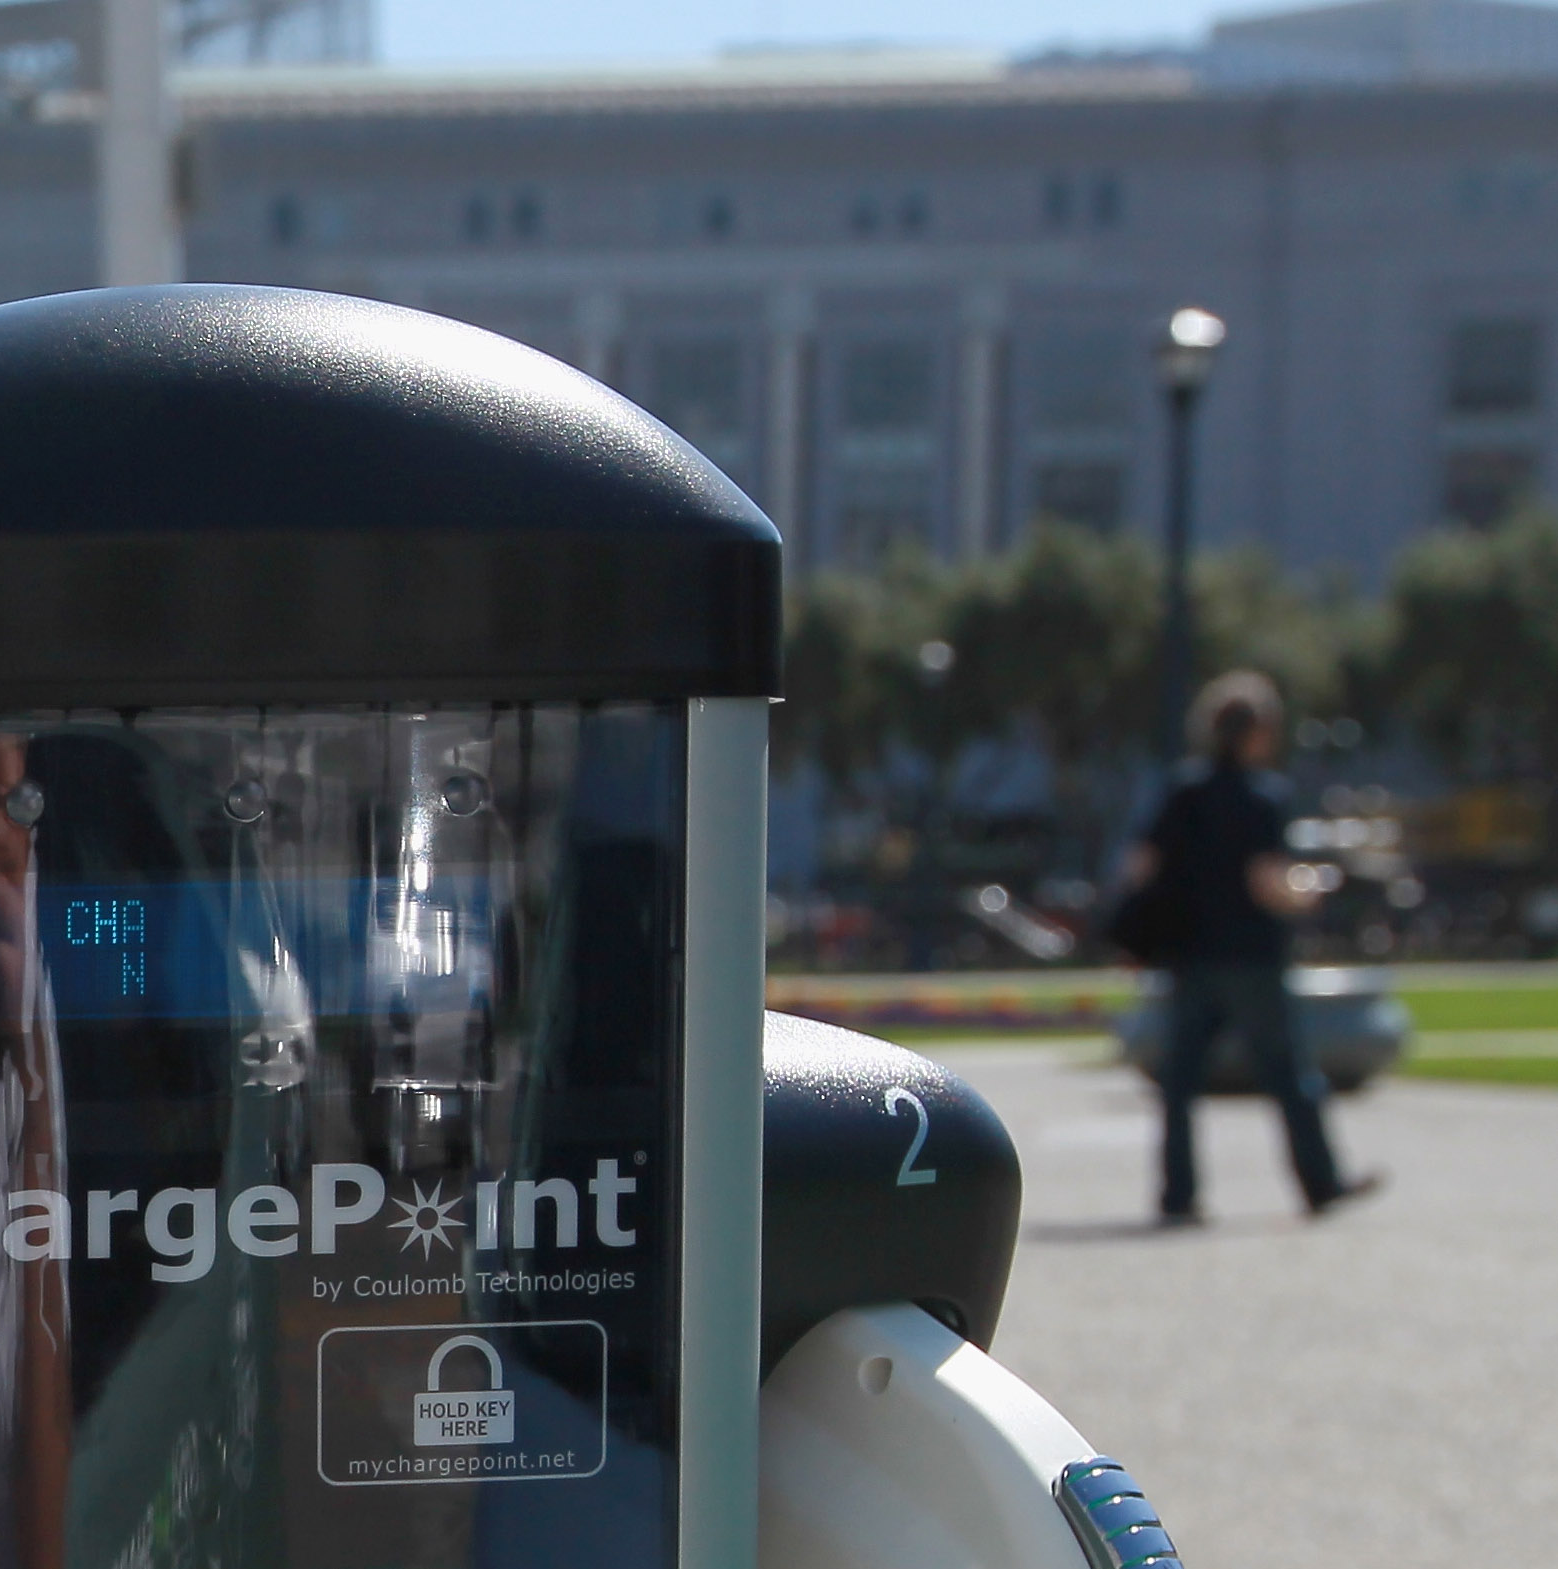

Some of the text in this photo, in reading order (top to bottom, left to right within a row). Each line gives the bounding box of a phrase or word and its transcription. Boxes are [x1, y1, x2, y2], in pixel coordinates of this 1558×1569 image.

[67, 900, 144, 944] CHA
[123, 952, 144, 995] N
[884, 1085, 937, 1186] 2
[313, 1268, 635, 1302] by Coulomb Technologies
[419, 1400, 511, 1419] HOLD KEY
[441, 1420, 488, 1437] HERE
[348, 1451, 576, 1478] mychargepoint.net
